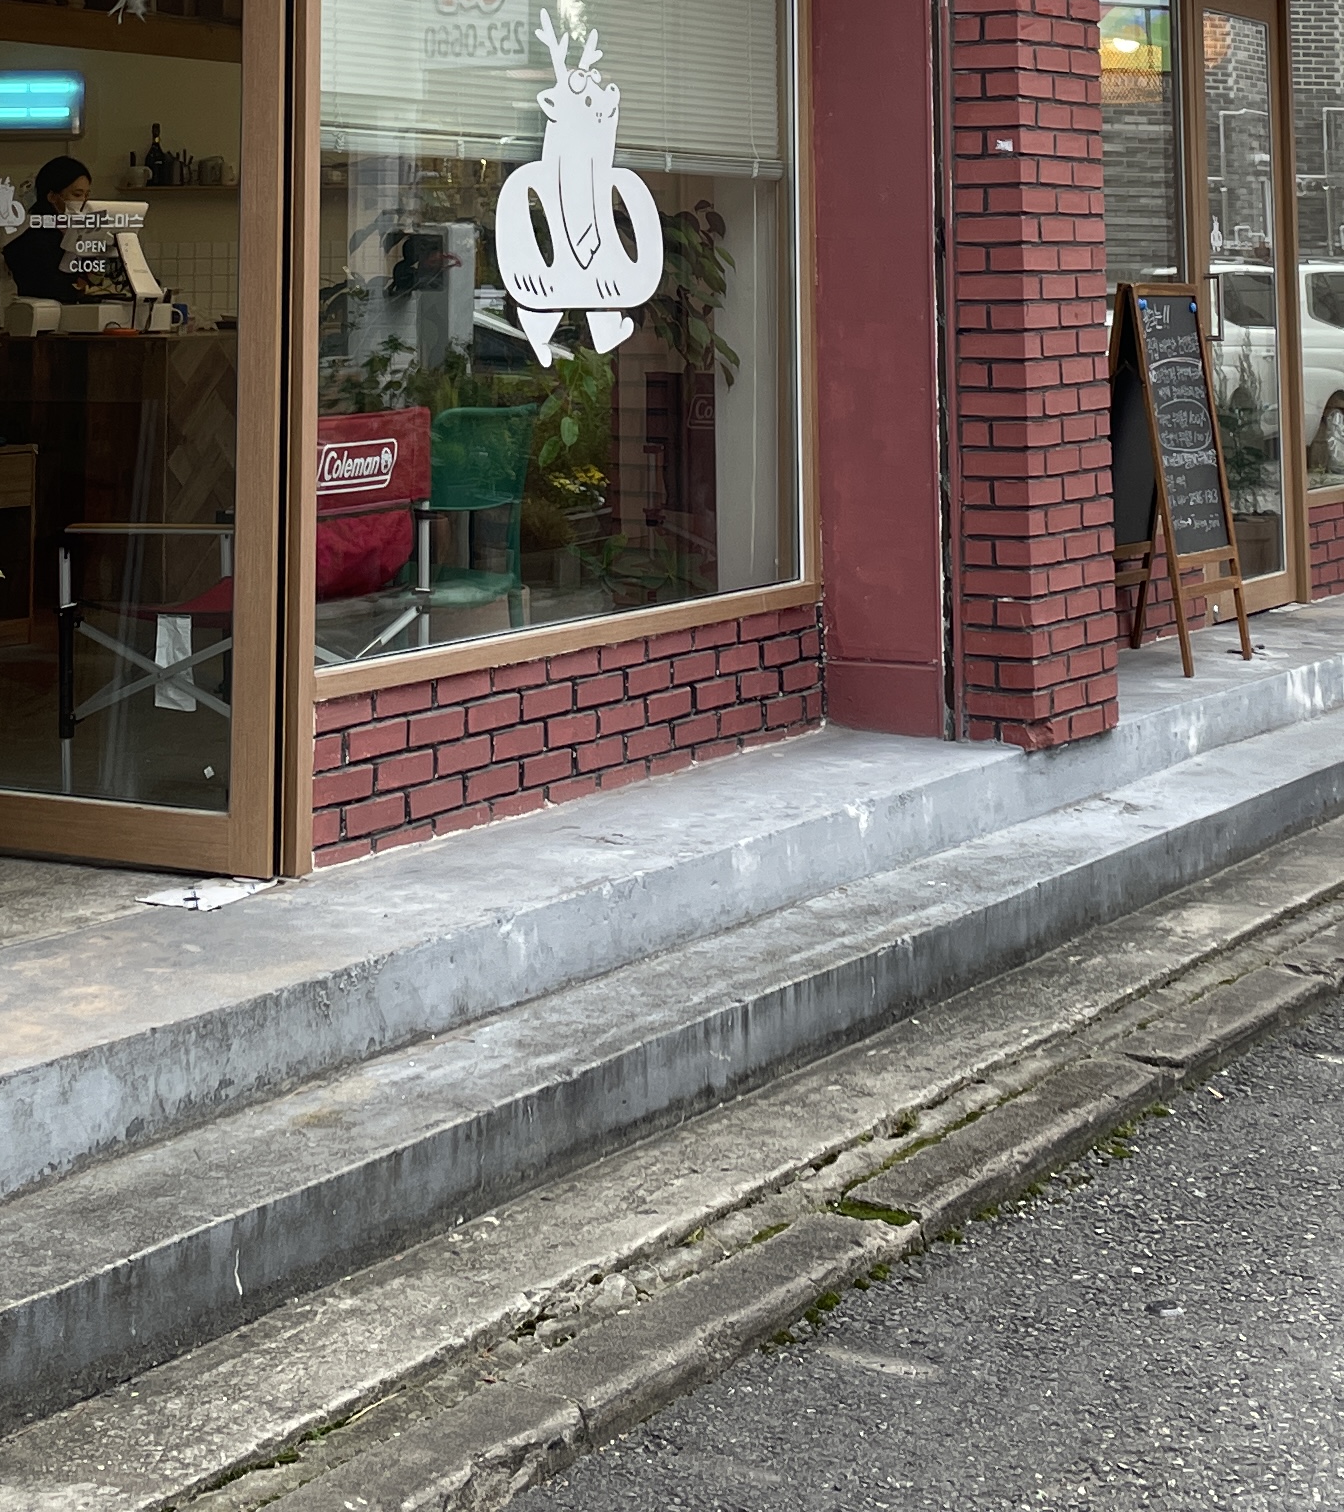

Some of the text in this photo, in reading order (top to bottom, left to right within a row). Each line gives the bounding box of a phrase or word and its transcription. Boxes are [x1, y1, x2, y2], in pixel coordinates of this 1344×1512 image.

[75, 240, 107, 253] OPEN
[69, 259, 107, 273] CLOSE
[324, 450, 381, 481] Coleman
